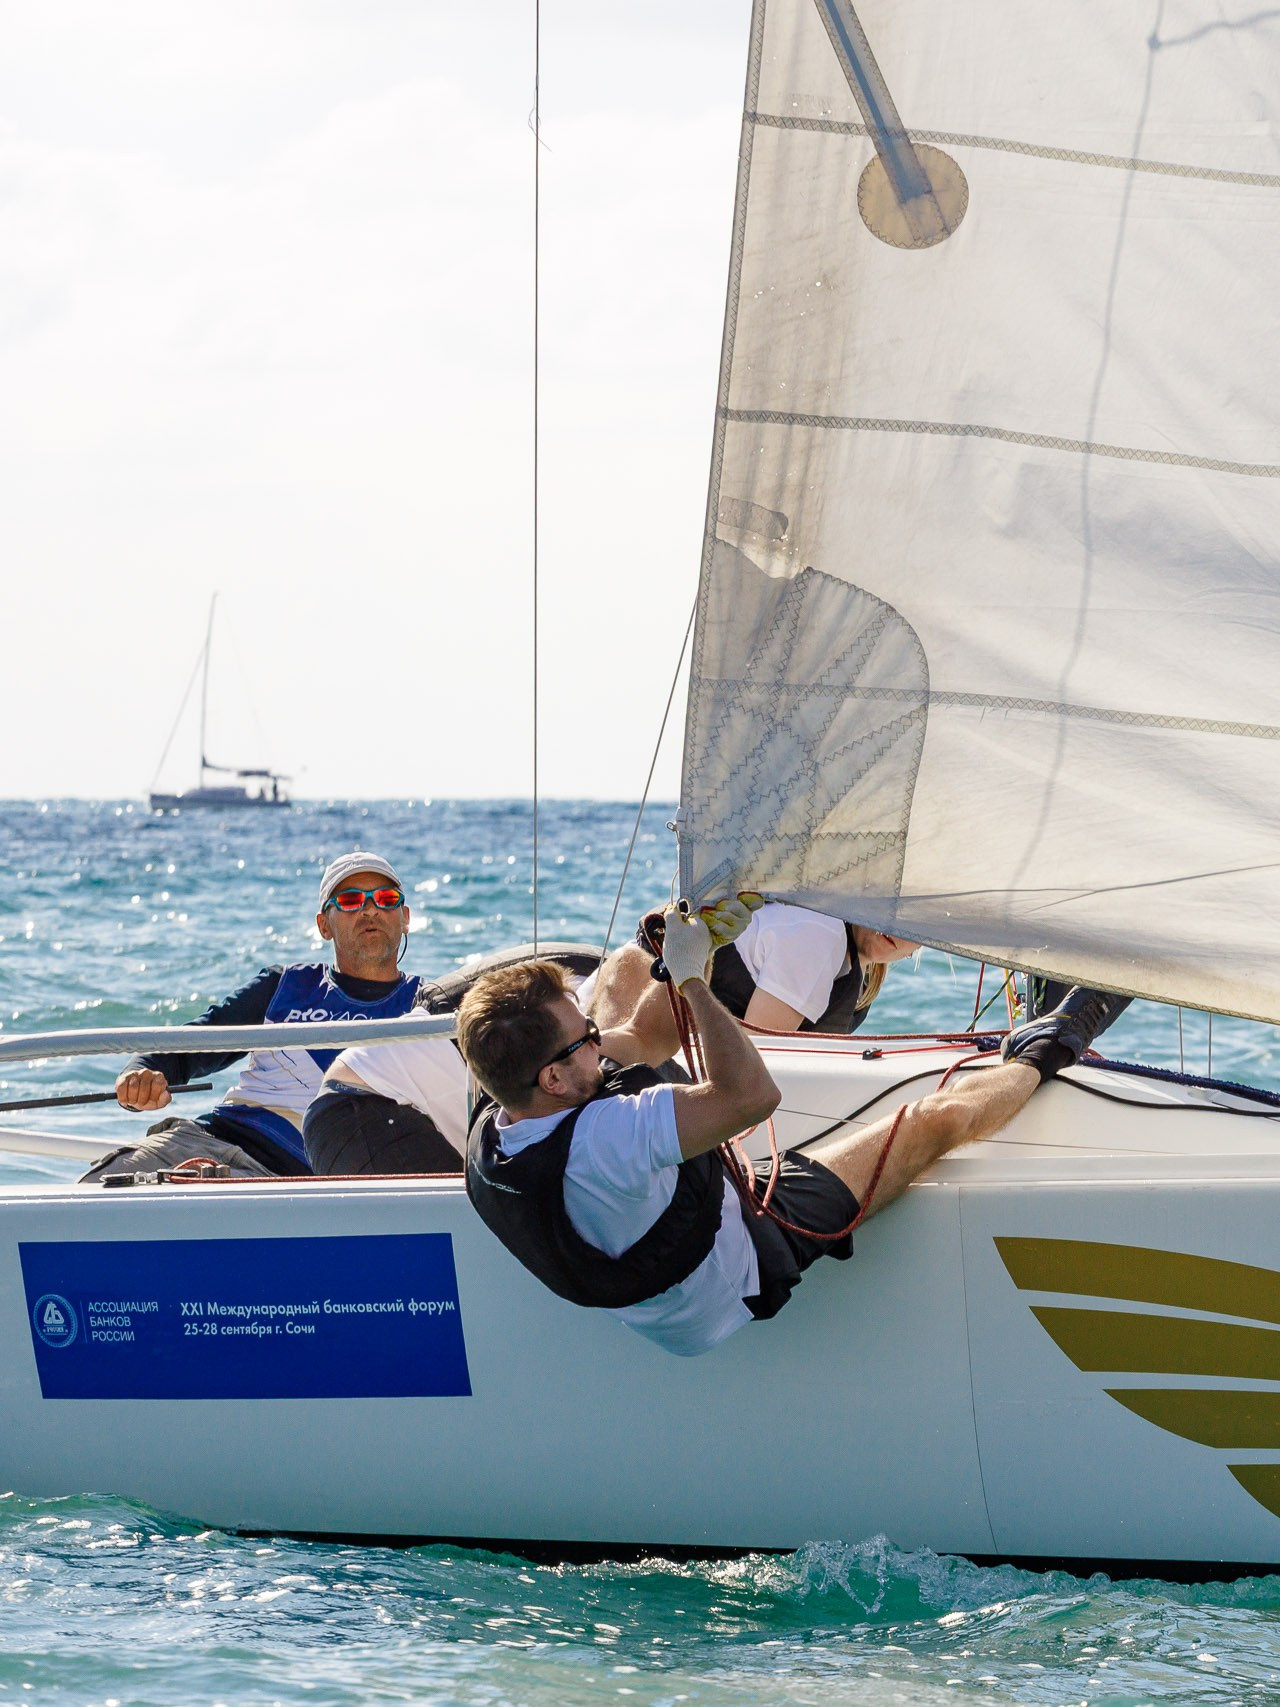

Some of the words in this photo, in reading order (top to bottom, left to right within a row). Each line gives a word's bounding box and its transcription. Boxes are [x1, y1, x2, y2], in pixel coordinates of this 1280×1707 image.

[284, 1008, 373, 1023] PROYAC
[88, 1301, 159, 1314] АССОЦИАЦИЯ
[207, 1301, 321, 1319] Международный
[323, 1298, 405, 1314] банковский
[408, 1297, 455, 1316] форум
[90, 1316, 132, 1327] БАНКОВ
[92, 1330, 135, 1341] РОССИИ
[183, 1322, 218, 1336] 25-28
[220, 1321, 272, 1338] сентября
[275, 1325, 283, 1334] г.
[285, 1321, 315, 1334] Сочи
